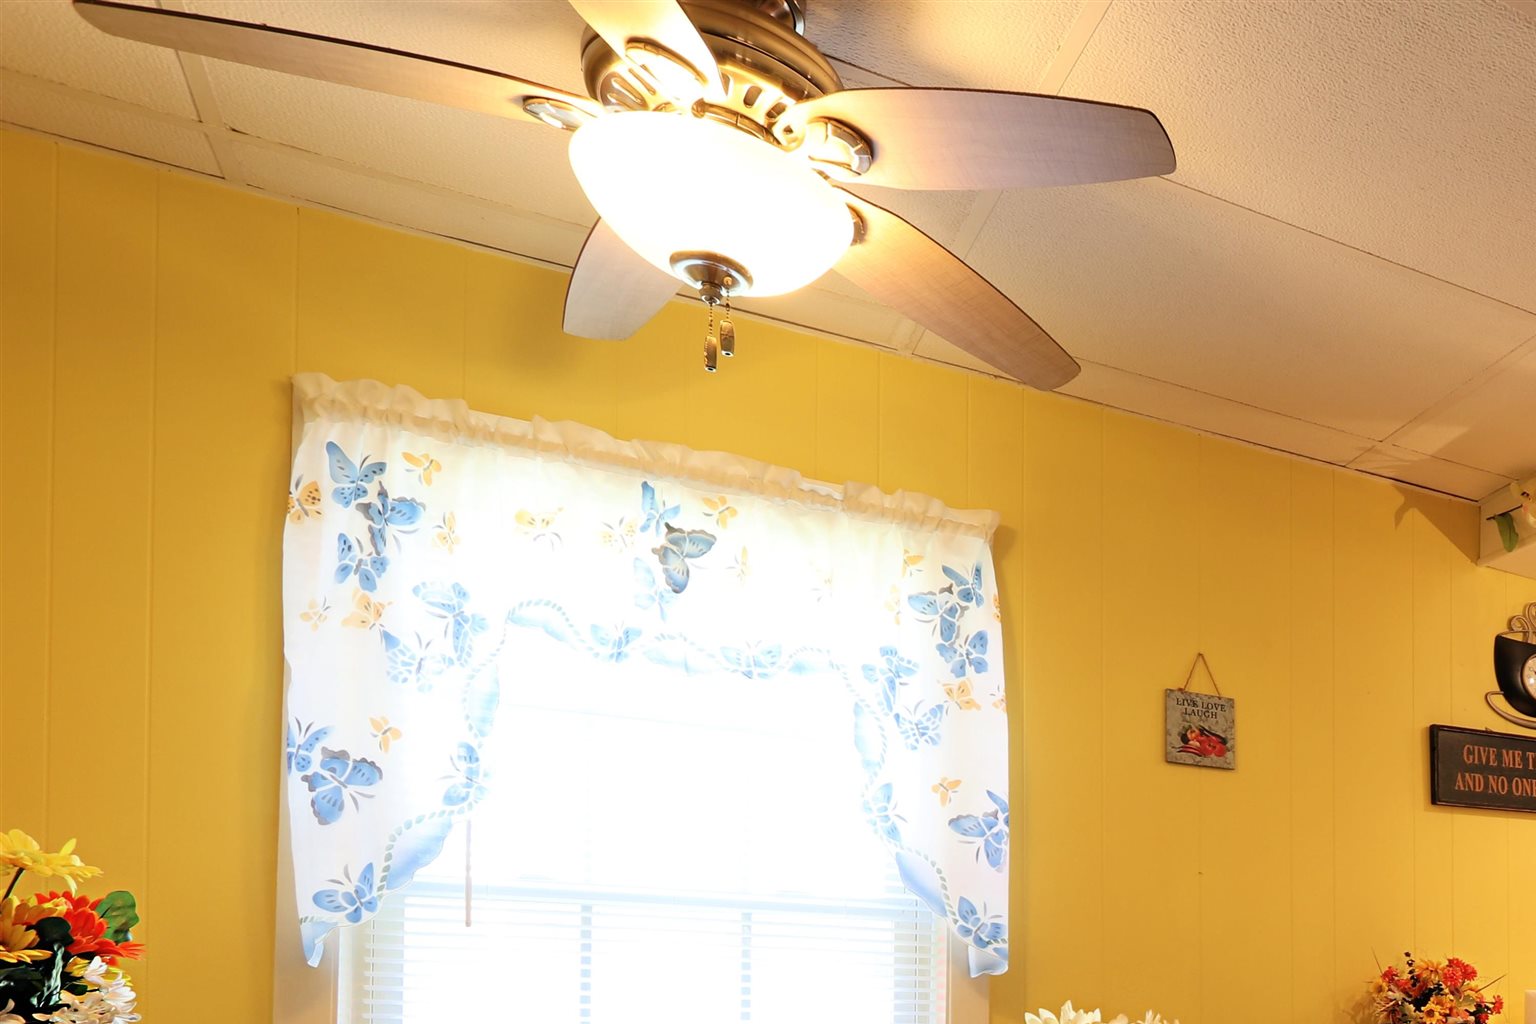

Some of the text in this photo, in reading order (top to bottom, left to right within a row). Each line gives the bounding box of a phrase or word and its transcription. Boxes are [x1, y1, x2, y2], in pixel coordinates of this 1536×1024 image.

[1176, 697, 1227, 713] LIVE LOVE
[1184, 707, 1218, 719] LAUGH
[1463, 744, 1498, 766] GIVE
[1502, 749, 1523, 769] ME
[1455, 772, 1484, 792] AND
[1488, 775, 1509, 795] NO
